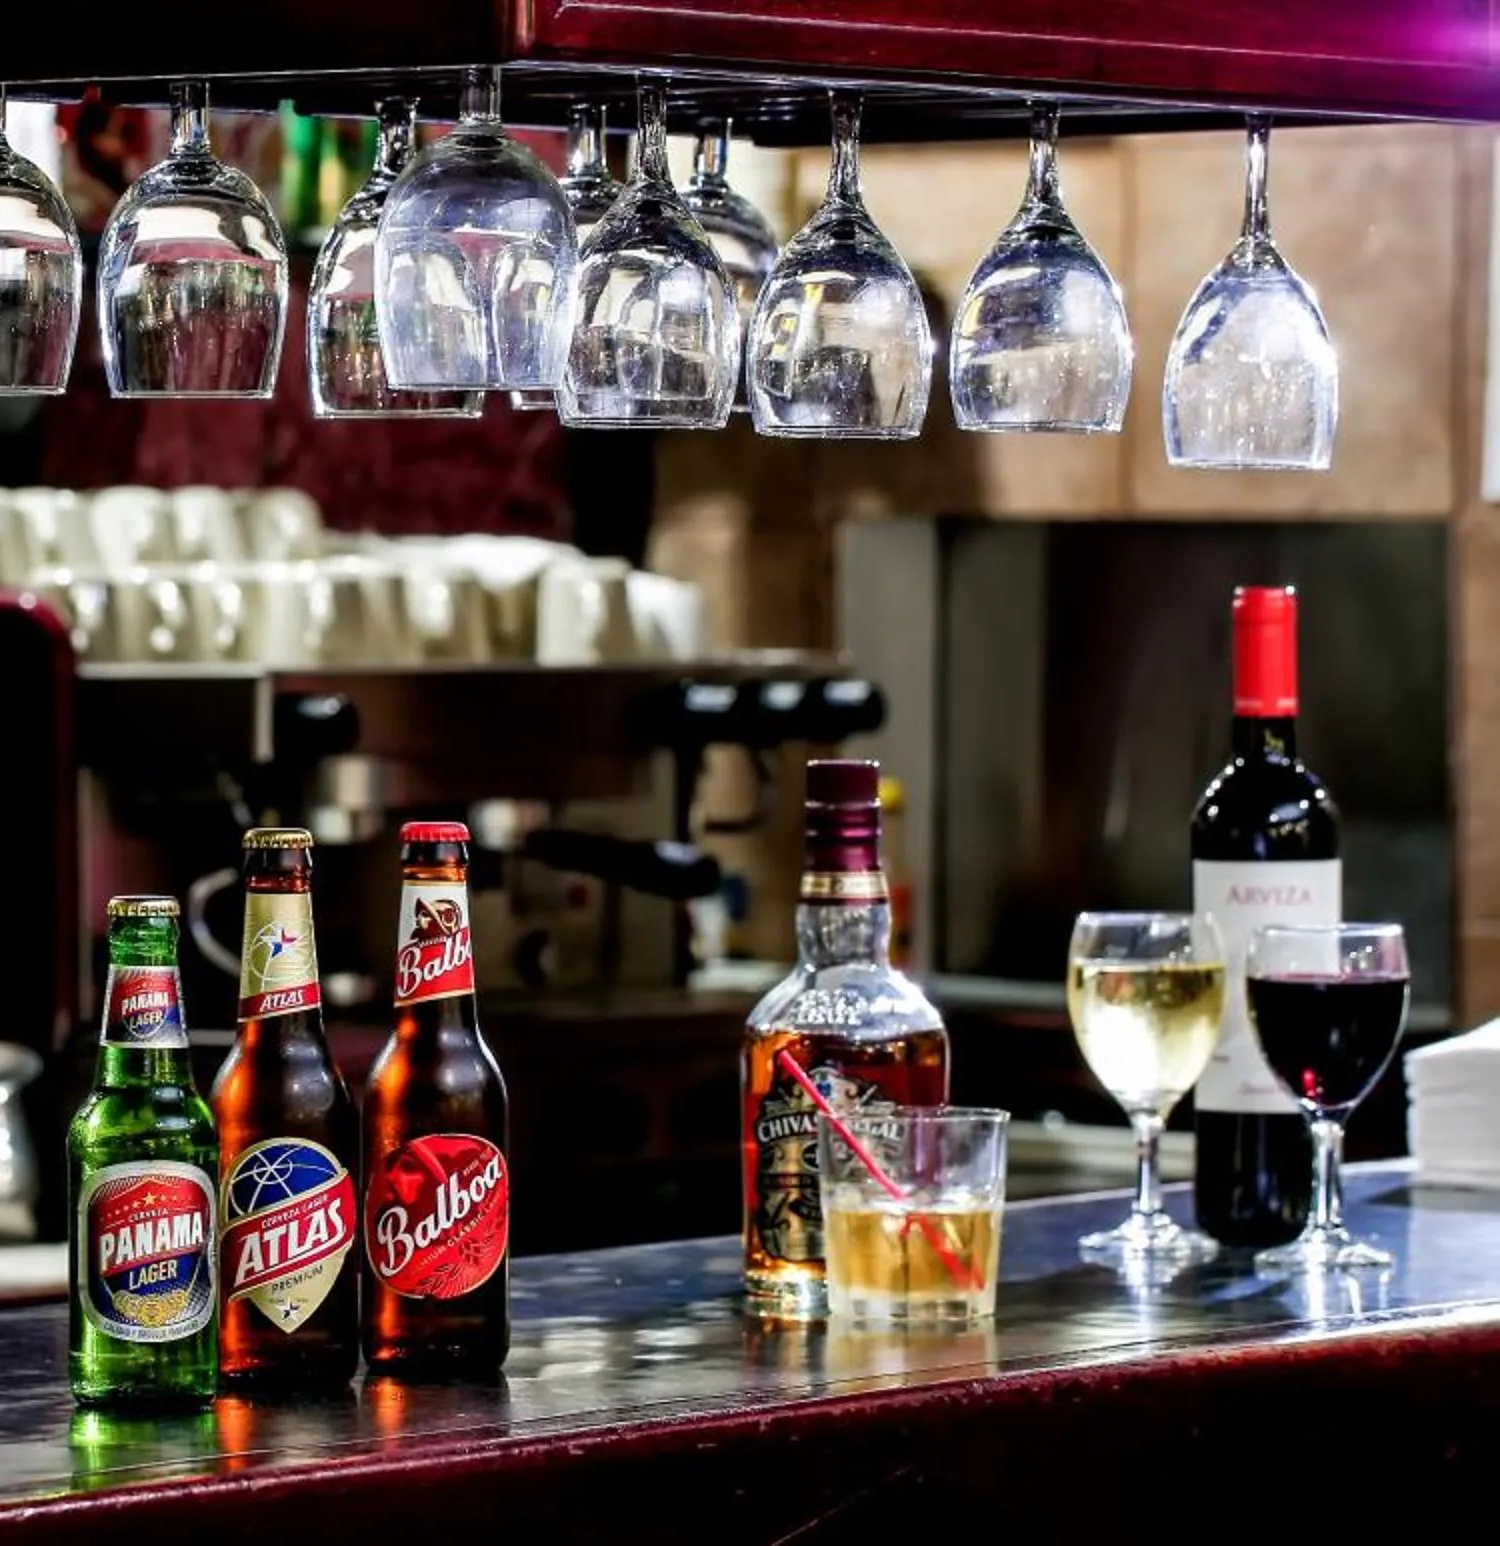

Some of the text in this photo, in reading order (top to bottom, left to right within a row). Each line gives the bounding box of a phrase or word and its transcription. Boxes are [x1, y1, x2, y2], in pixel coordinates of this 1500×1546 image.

[1226, 885, 1313, 906] ARVIZA
[121, 991, 169, 1016] PANAMA
[260, 989, 304, 1013] ATLAS
[129, 1009, 164, 1032] LAGER
[262, 1206, 300, 1230] CERVEZA
[376, 1152, 503, 1277] Balboa
[100, 1211, 204, 1275] PANAMA
[233, 1197, 346, 1289] ATLAS
[129, 1259, 178, 1291] LAGER
[270, 1264, 324, 1294] PREMIUM
